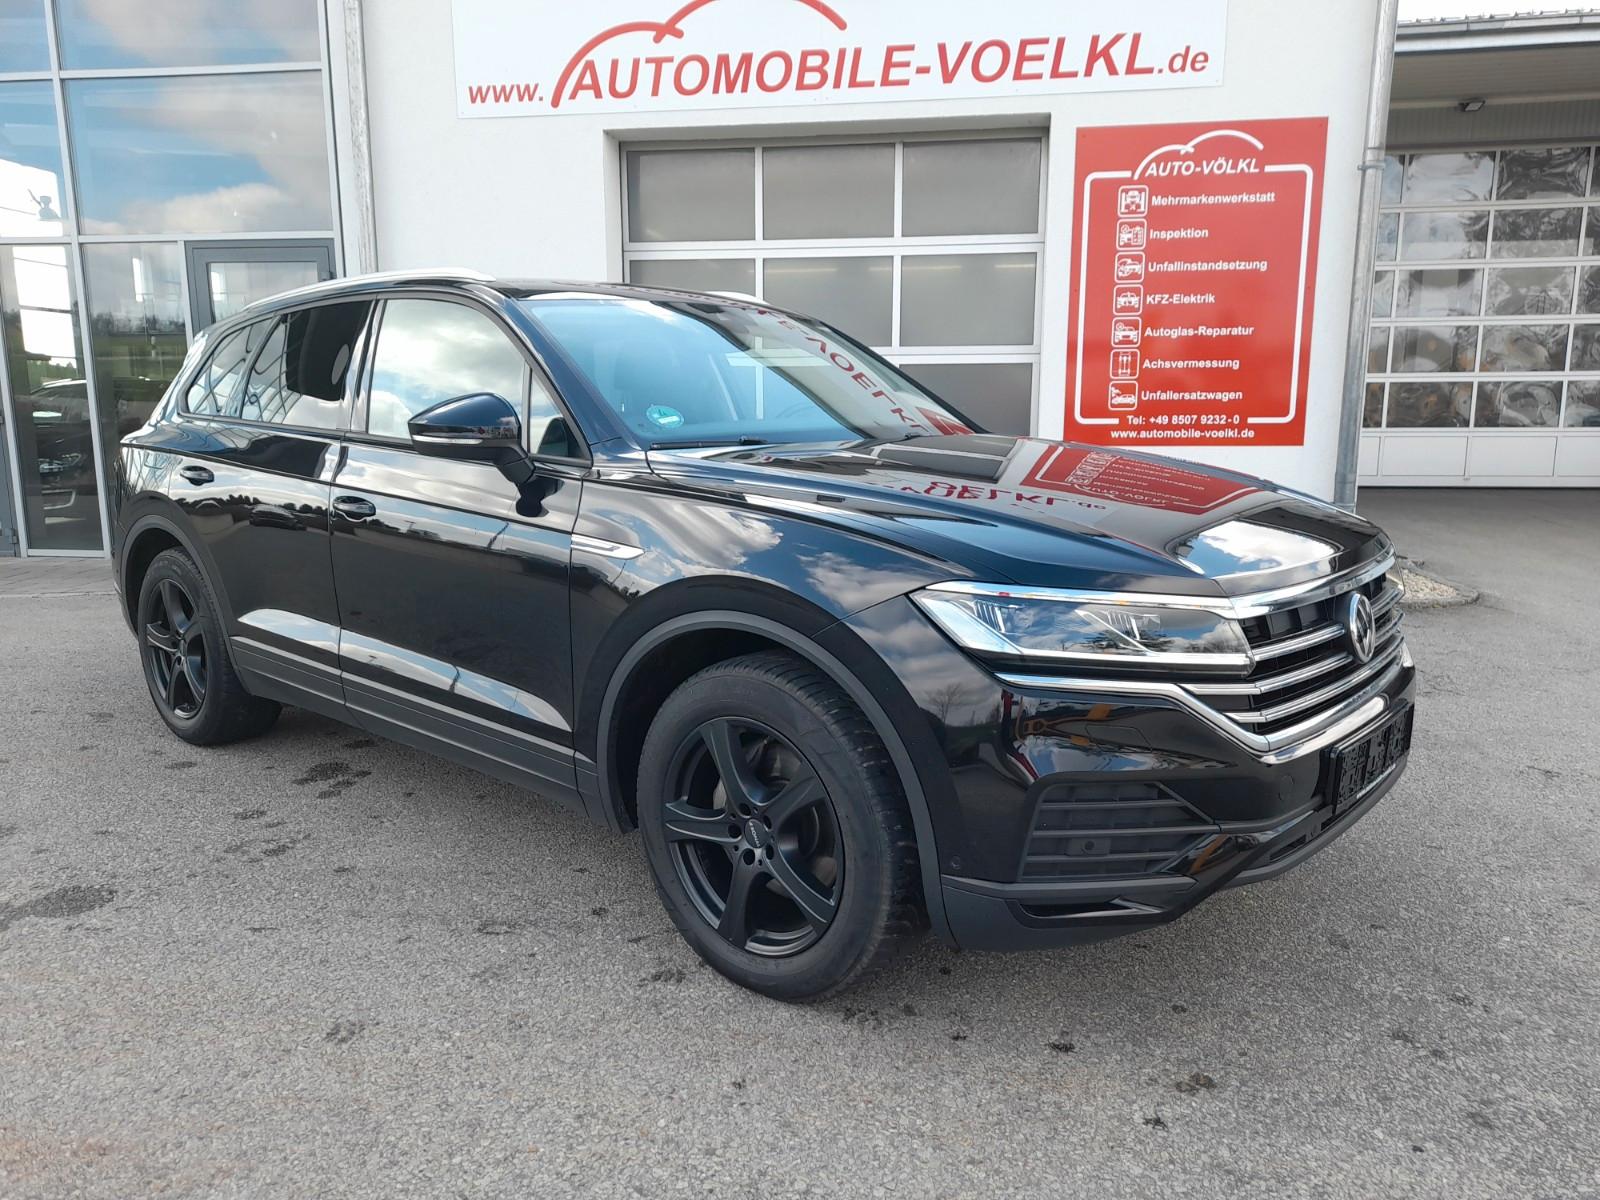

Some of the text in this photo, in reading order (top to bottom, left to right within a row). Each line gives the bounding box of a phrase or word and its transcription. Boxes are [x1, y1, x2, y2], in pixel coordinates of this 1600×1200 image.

[1145, 157, 1261, 177] AUTO-VÖLKL
[1151, 191, 1276, 206] Mehrmarkenwerkstatt
[1149, 227, 1209, 241] Inspektion
[1148, 260, 1268, 273] Unfallinstandsetzung
[1146, 293, 1216, 305] KFZ-Elektrik
[1144, 325, 1255, 339] Autoglas-Reparatur
[1142, 358, 1240, 370] Achsvermessung
[1141, 390, 1243, 402] Unfallersatzwagen
[1126, 415, 1146, 425] Tel:
[1149, 415, 1169, 425] +49
[1171, 414, 1198, 425] 8507
[1110, 428, 1255, 438] www.automobile-voelkl.de
